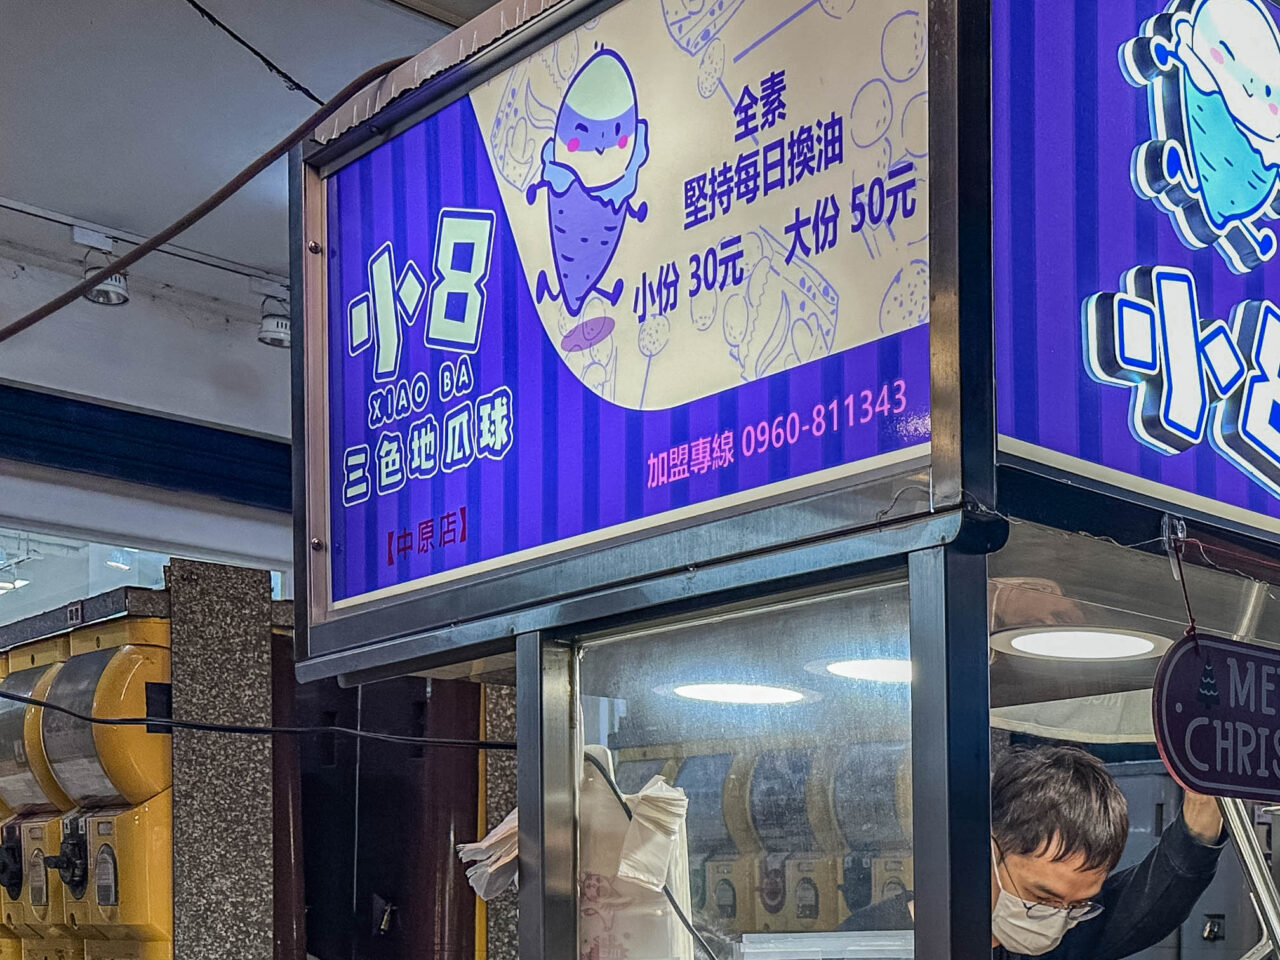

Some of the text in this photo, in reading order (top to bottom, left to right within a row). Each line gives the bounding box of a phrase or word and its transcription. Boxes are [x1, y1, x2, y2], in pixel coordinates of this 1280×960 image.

[733, 69, 788, 143] 全素
[683, 112, 845, 232] 堅持每日換油
[783, 162, 918, 266] 大份 50元
[348, 207, 496, 382] 小8
[631, 234, 746, 324] 小份 30元
[368, 355, 473, 429] XIAO BA
[646, 378, 909, 490] 加盟專線 0960-811343
[343, 386, 513, 507] 三色地瓜球
